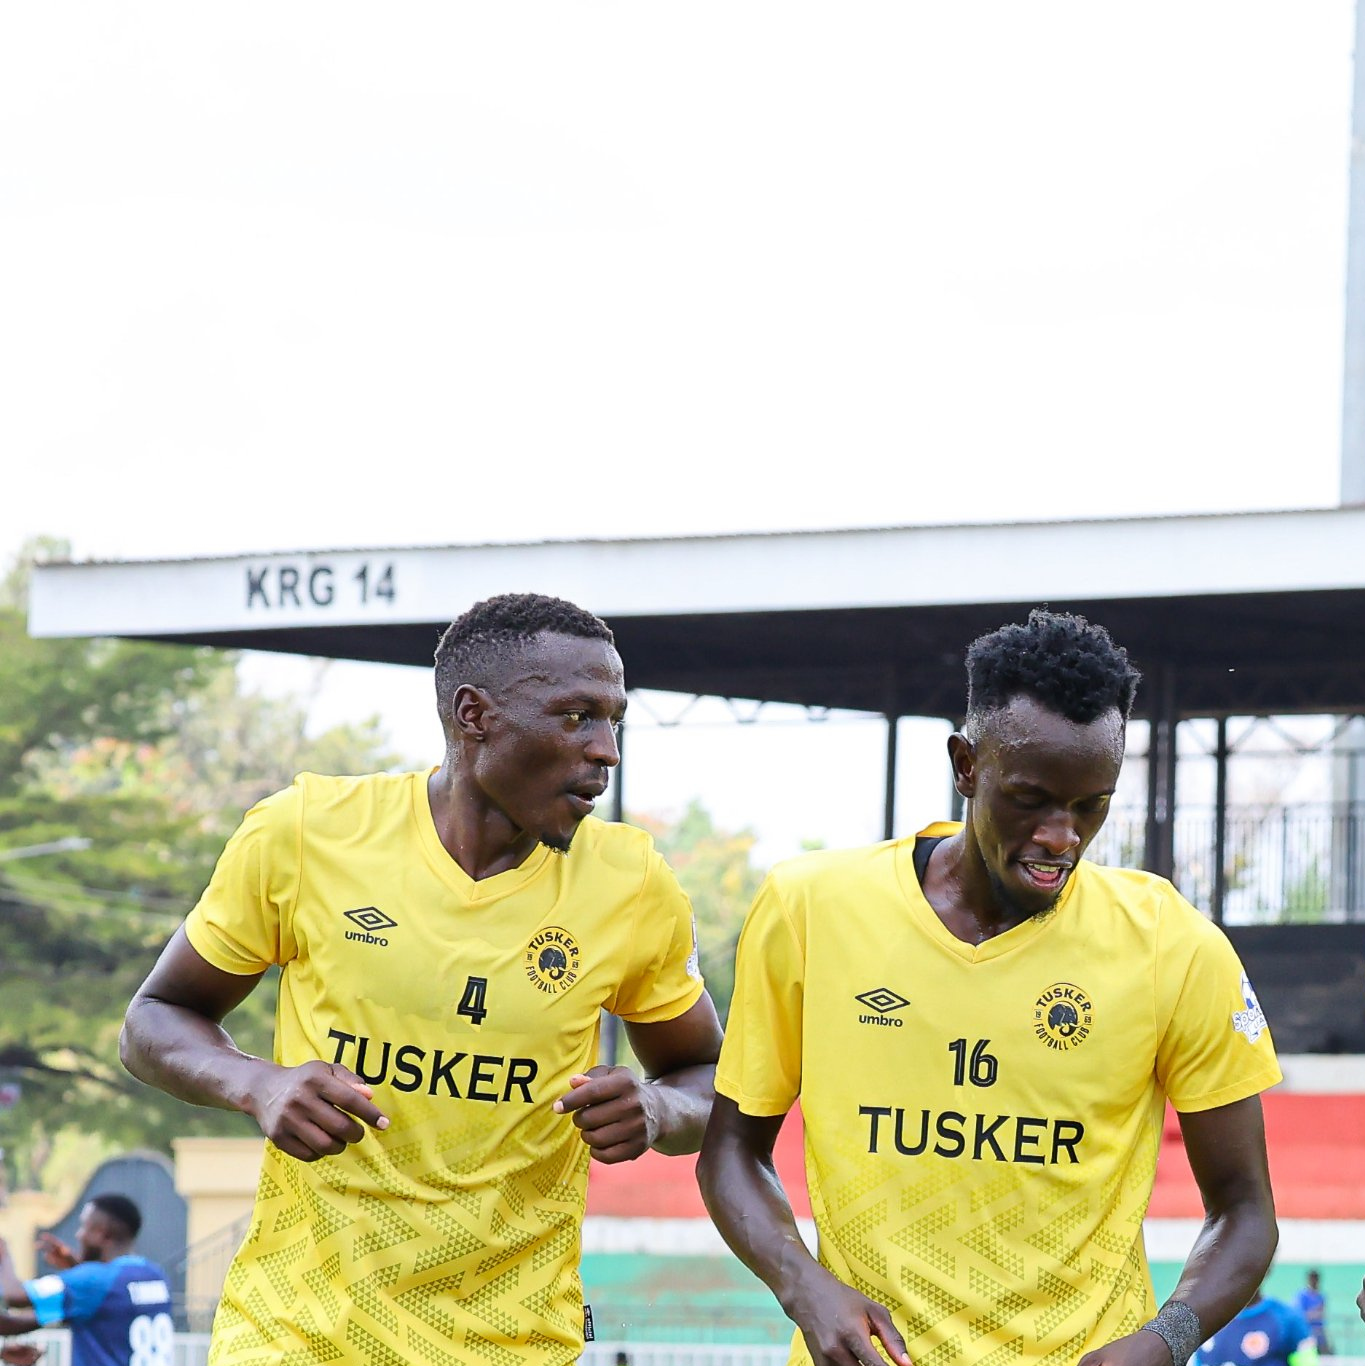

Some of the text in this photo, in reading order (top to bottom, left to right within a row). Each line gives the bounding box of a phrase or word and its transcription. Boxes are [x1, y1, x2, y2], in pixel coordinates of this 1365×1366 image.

[247, 563, 395, 608] KRG 14
[344, 930, 389, 947] umbro
[528, 931, 579, 957] TUSKER
[525, 966, 577, 994] FOOTBALL CLUB
[456, 975, 488, 1026] 4
[1036, 987, 1091, 1012] TUSKER
[858, 1014, 903, 1028] umbro
[1034, 1023, 1089, 1051] FOOTBALL CLUB
[328, 1027, 539, 1104] TUSKER
[948, 1038, 998, 1088] 16
[858, 1104, 1085, 1166] TUSKER
